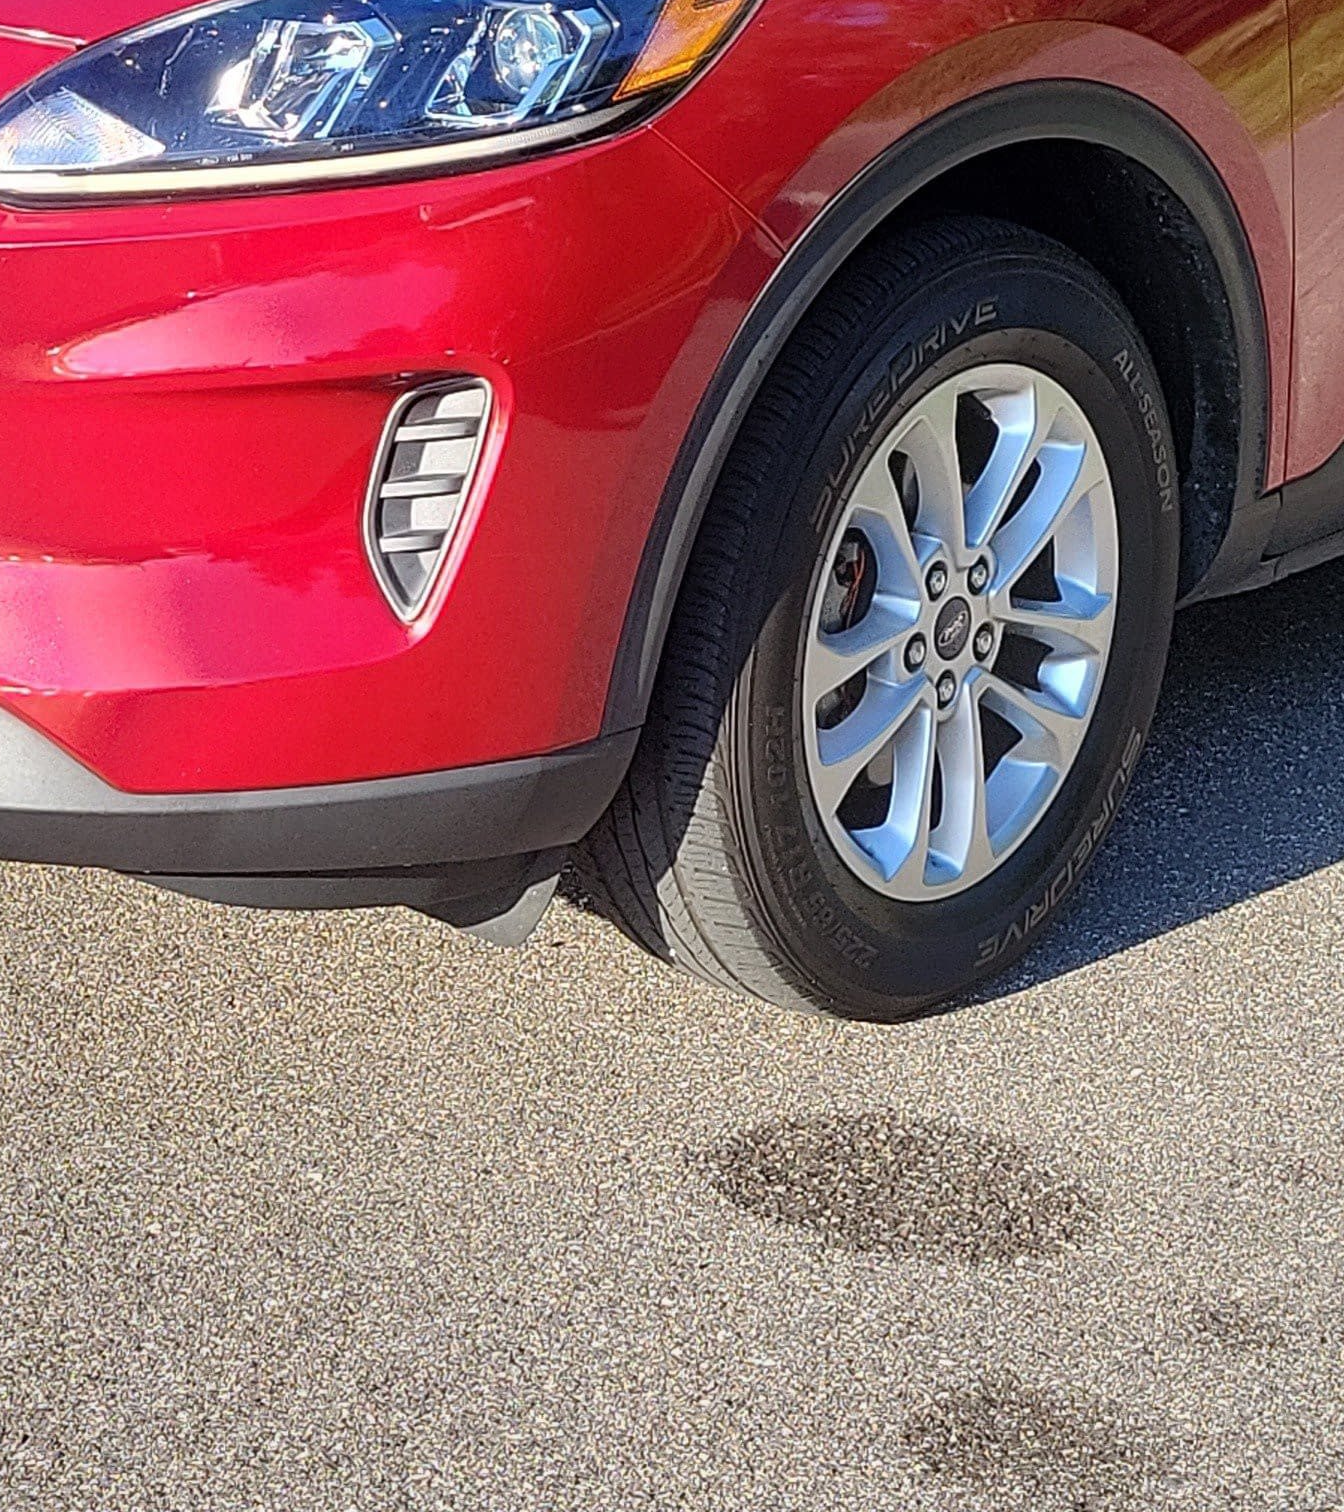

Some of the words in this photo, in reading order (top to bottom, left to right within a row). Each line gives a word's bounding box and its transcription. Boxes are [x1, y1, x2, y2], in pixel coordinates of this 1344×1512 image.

[812, 296, 999, 532] SUREDRIVE
[1113, 348, 1173, 512] ALL-SEASON
[972, 726, 1142, 968] SUREDRIVE
